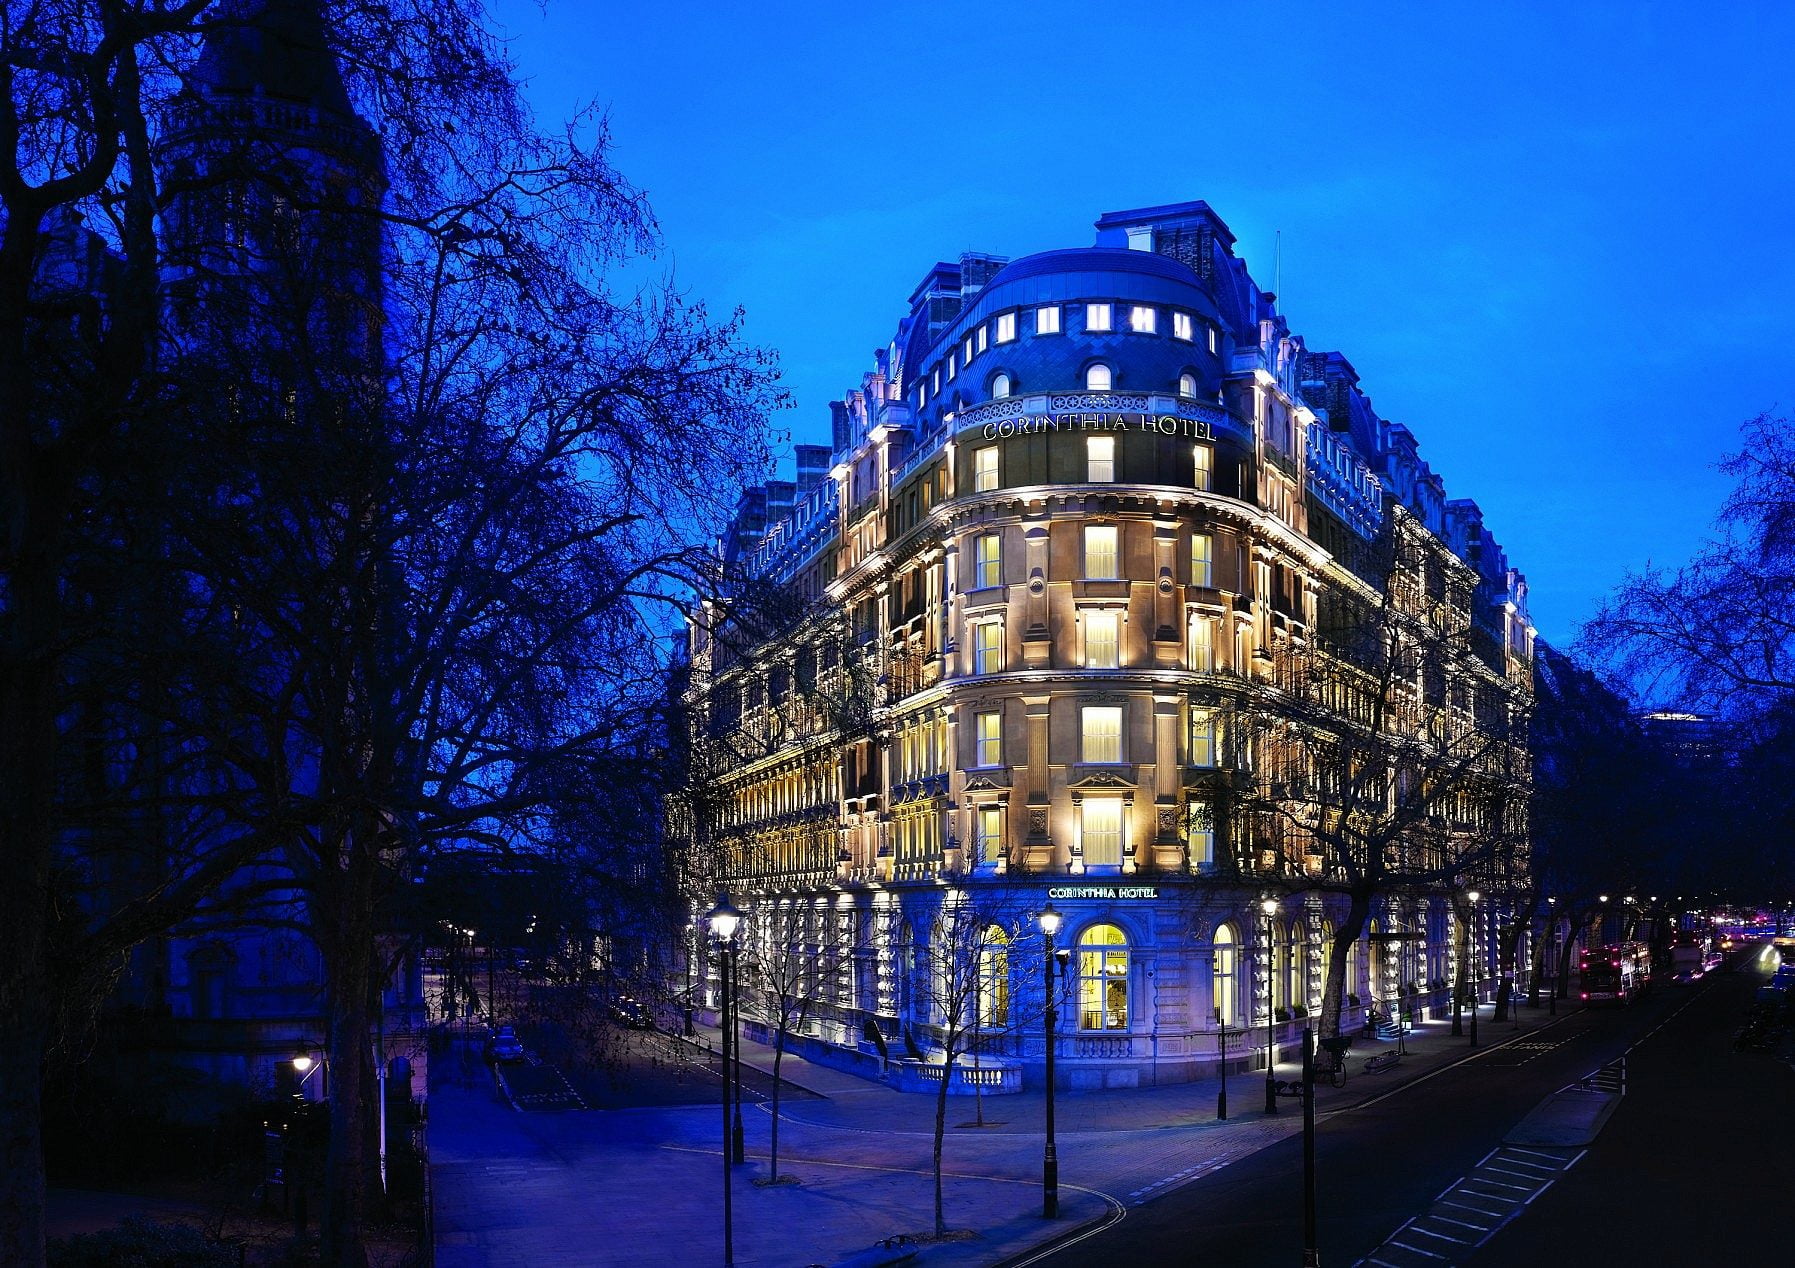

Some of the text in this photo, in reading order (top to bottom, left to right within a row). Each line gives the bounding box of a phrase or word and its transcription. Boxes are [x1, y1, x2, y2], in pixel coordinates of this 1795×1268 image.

[982, 413, 1217, 442] CORINTHIA HOTEL
[1048, 887, 1158, 898] CORINTHIA HOTEL
